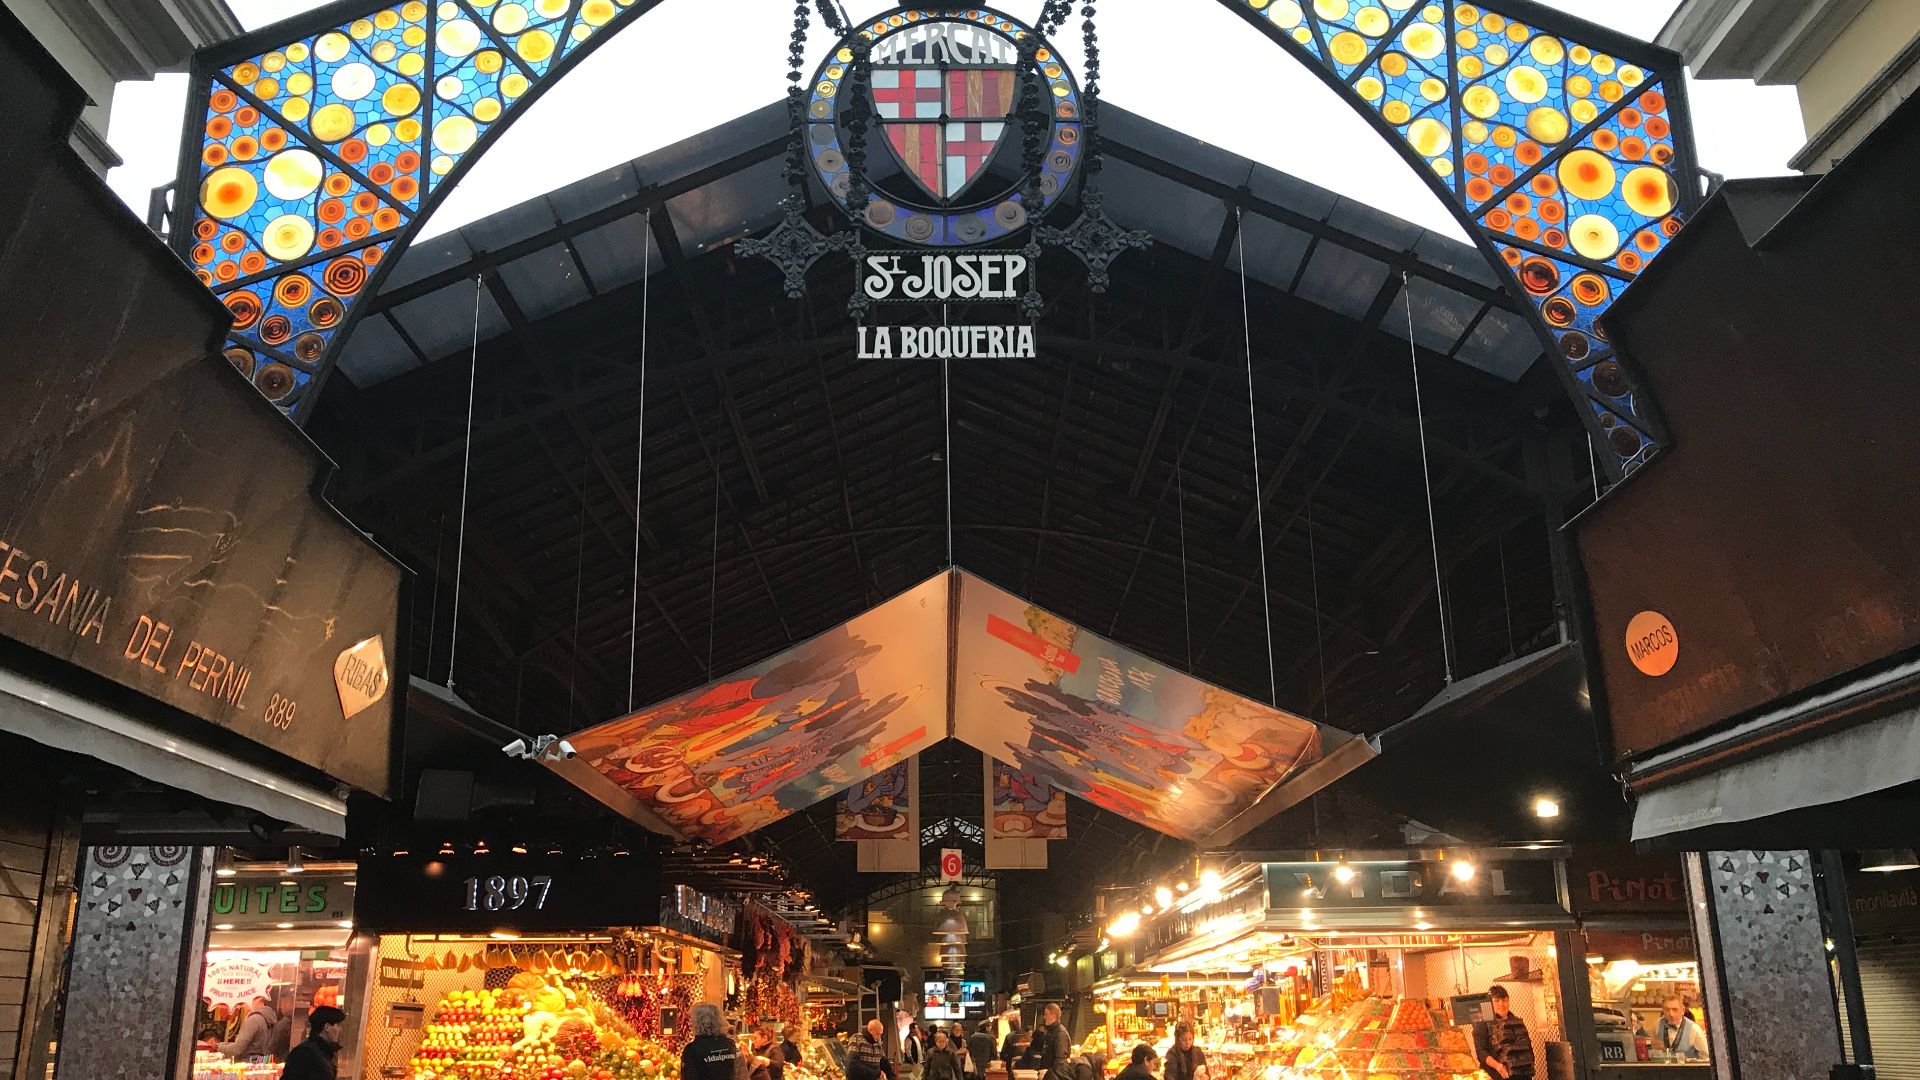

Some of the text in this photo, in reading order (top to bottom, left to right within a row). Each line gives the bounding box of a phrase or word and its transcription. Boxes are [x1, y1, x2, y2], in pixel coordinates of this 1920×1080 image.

[876, 23, 1012, 65] MERCAT
[902, 254, 1027, 299] JOSEP
[857, 325, 1036, 358] LA BOQUERIA
[0, 540, 296, 731] ESANIA DEL PERNIL 889
[1631, 625, 1673, 661] MARCOS
[341, 653, 382, 699] RIBAS
[947, 857, 957, 873] 6
[214, 884, 327, 914] UITES
[462, 875, 552, 911] 1897
[208, 967, 227, 979] 100%
[229, 964, 262, 979] NATURAL
[382, 965, 399, 979] VIDAL
[209, 987, 257, 998] FRUITS JUICE
[1603, 1046, 1624, 1059] RB
